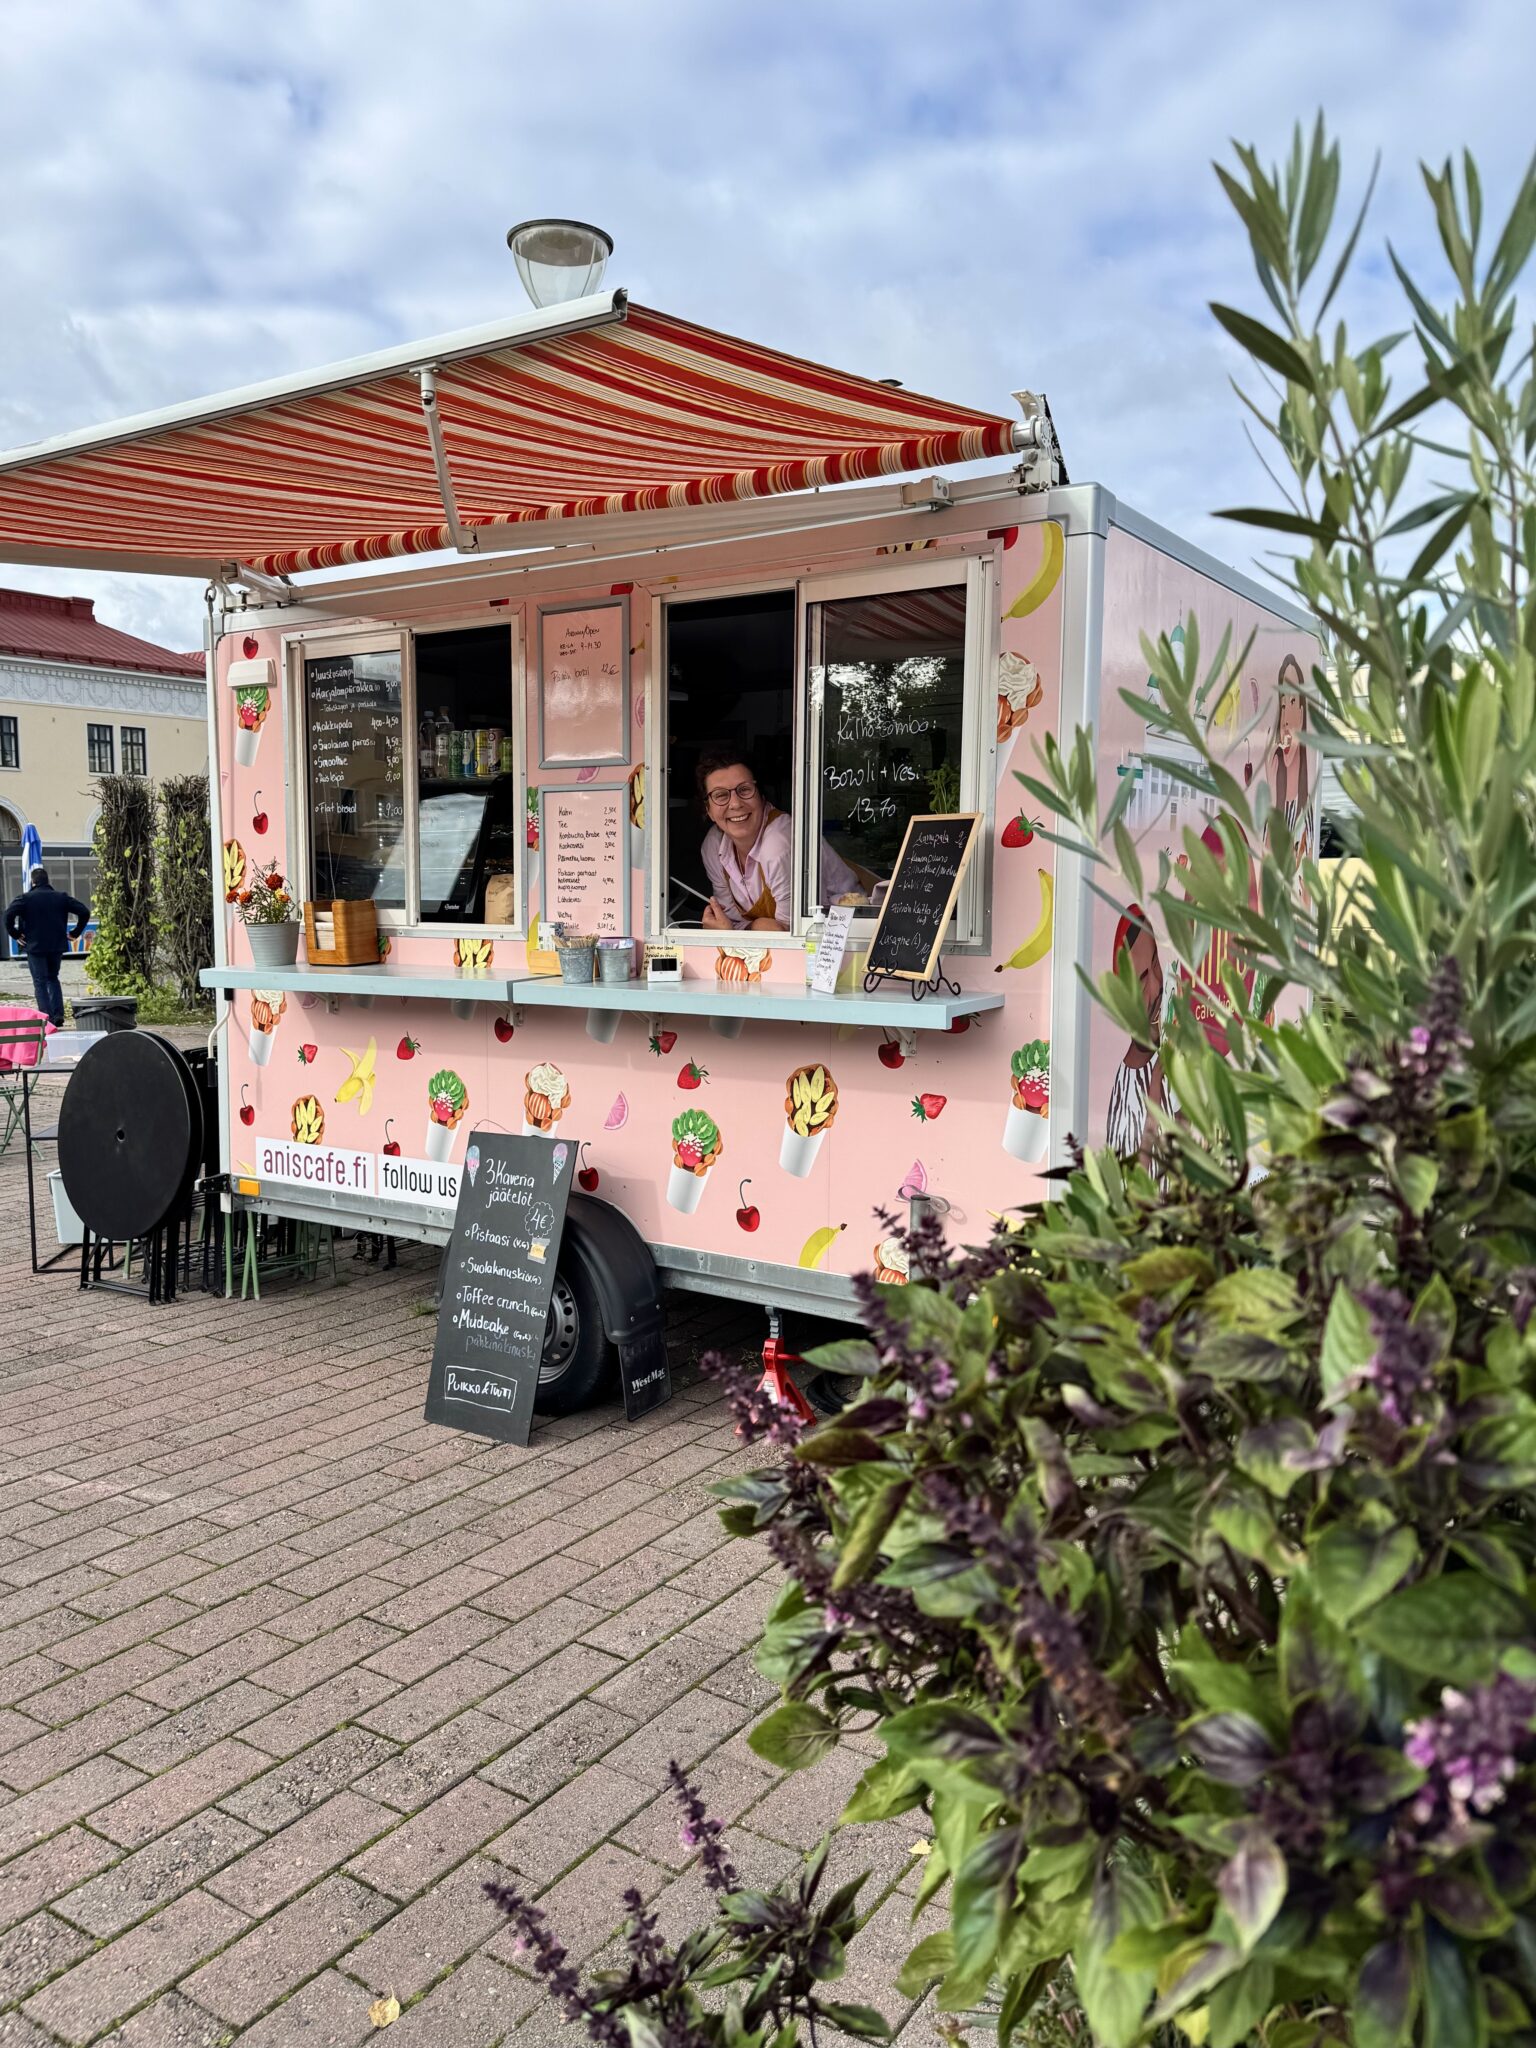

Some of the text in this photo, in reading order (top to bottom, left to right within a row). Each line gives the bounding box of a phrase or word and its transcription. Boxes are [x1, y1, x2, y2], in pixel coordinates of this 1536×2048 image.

[880, 765, 888, 779] +
[318, 801, 334, 815] Flat
[847, 796, 896, 824] 13,70
[558, 820, 568, 829] Tee
[263, 1145, 367, 1189] aniscafe.fi
[383, 1162, 457, 1198] follow us
[485, 1186, 533, 1208] jäätelöt
[530, 1208, 548, 1231] 4€
[470, 1222, 511, 1247] Pistaasi
[462, 1285, 494, 1305] Toffee
[496, 1297, 530, 1316] crunch
[458, 1308, 510, 1335] Mudcake
